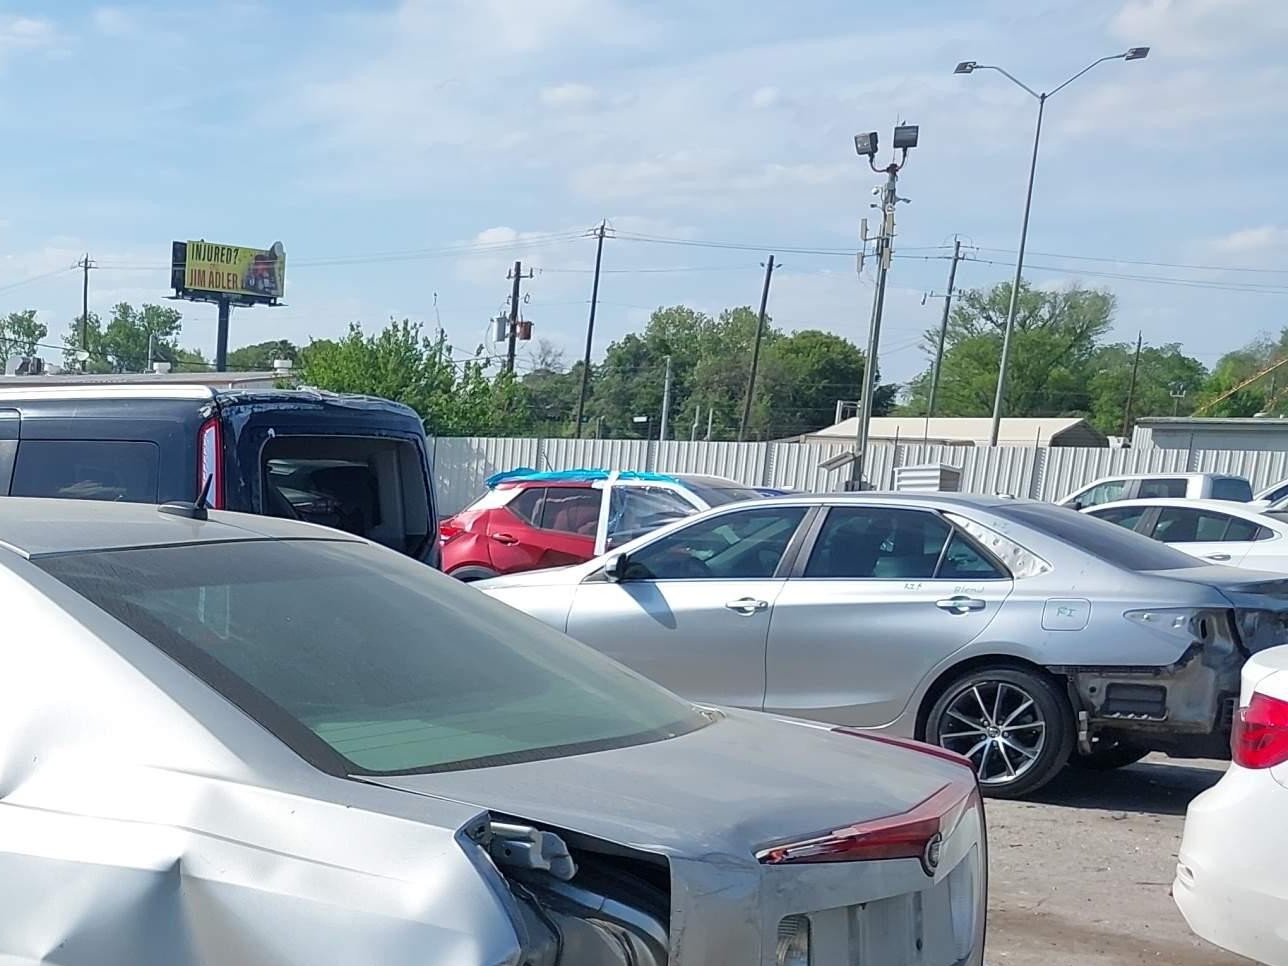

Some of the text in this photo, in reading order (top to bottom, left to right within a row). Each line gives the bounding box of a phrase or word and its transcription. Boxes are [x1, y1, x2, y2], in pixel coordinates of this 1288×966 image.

[191, 243, 240, 265] INJURED?
[189, 268, 239, 289] JIM ADLER
